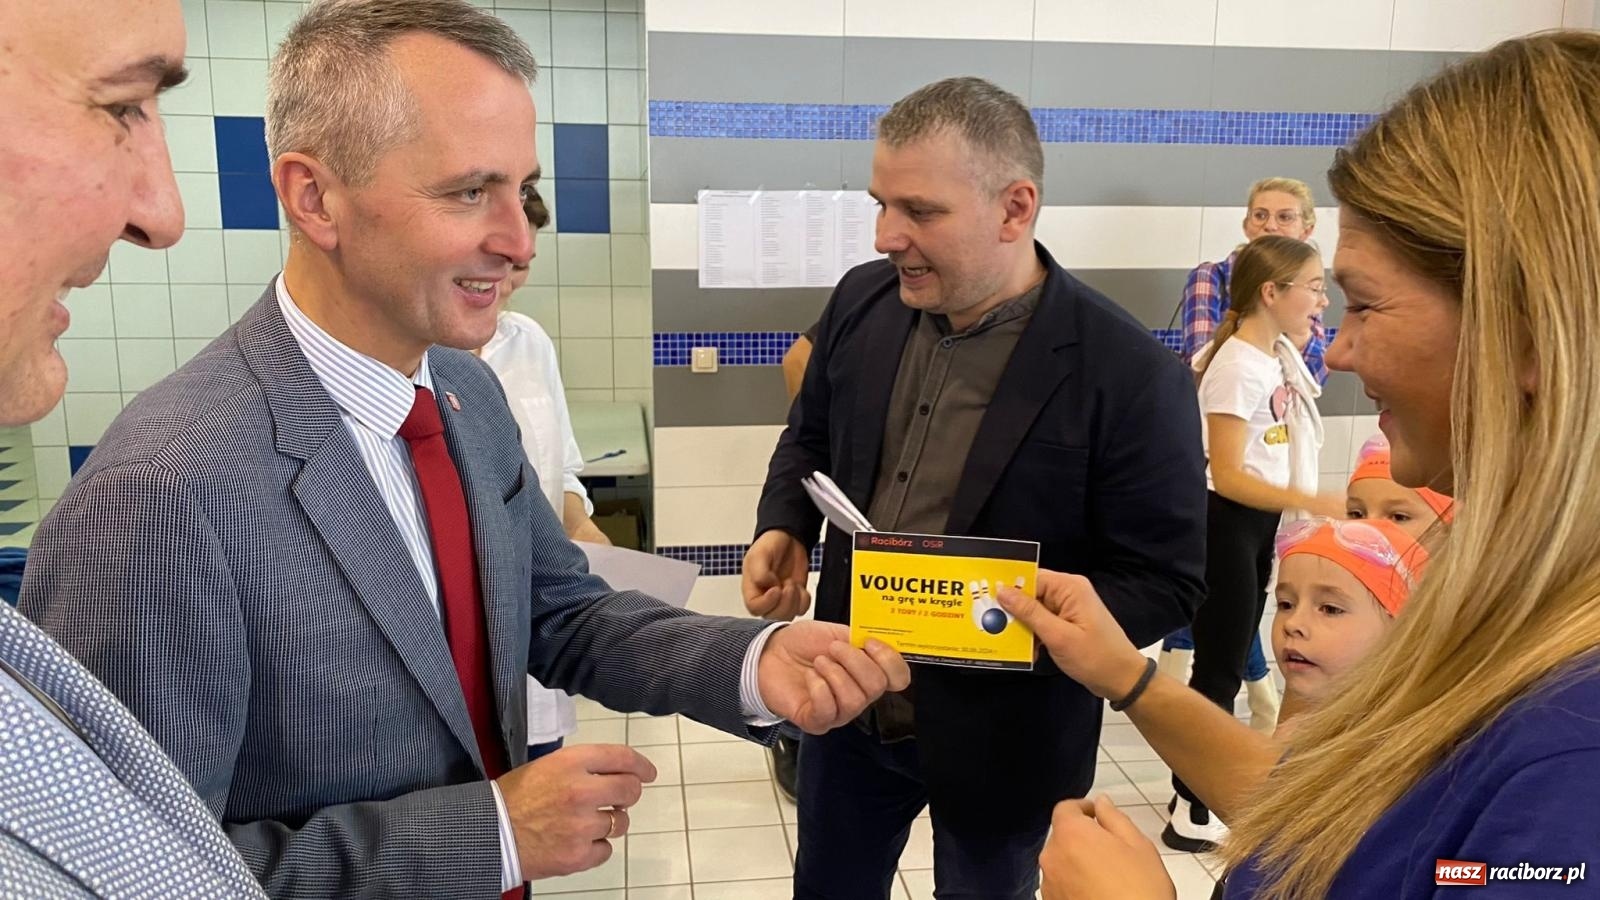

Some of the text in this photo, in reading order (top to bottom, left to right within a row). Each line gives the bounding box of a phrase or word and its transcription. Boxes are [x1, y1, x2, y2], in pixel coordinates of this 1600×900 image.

[870, 536, 913, 547] Racibórz
[859, 574, 964, 596] VOUCHER
[898, 596, 915, 605] grę
[930, 597, 963, 607] kręgle
